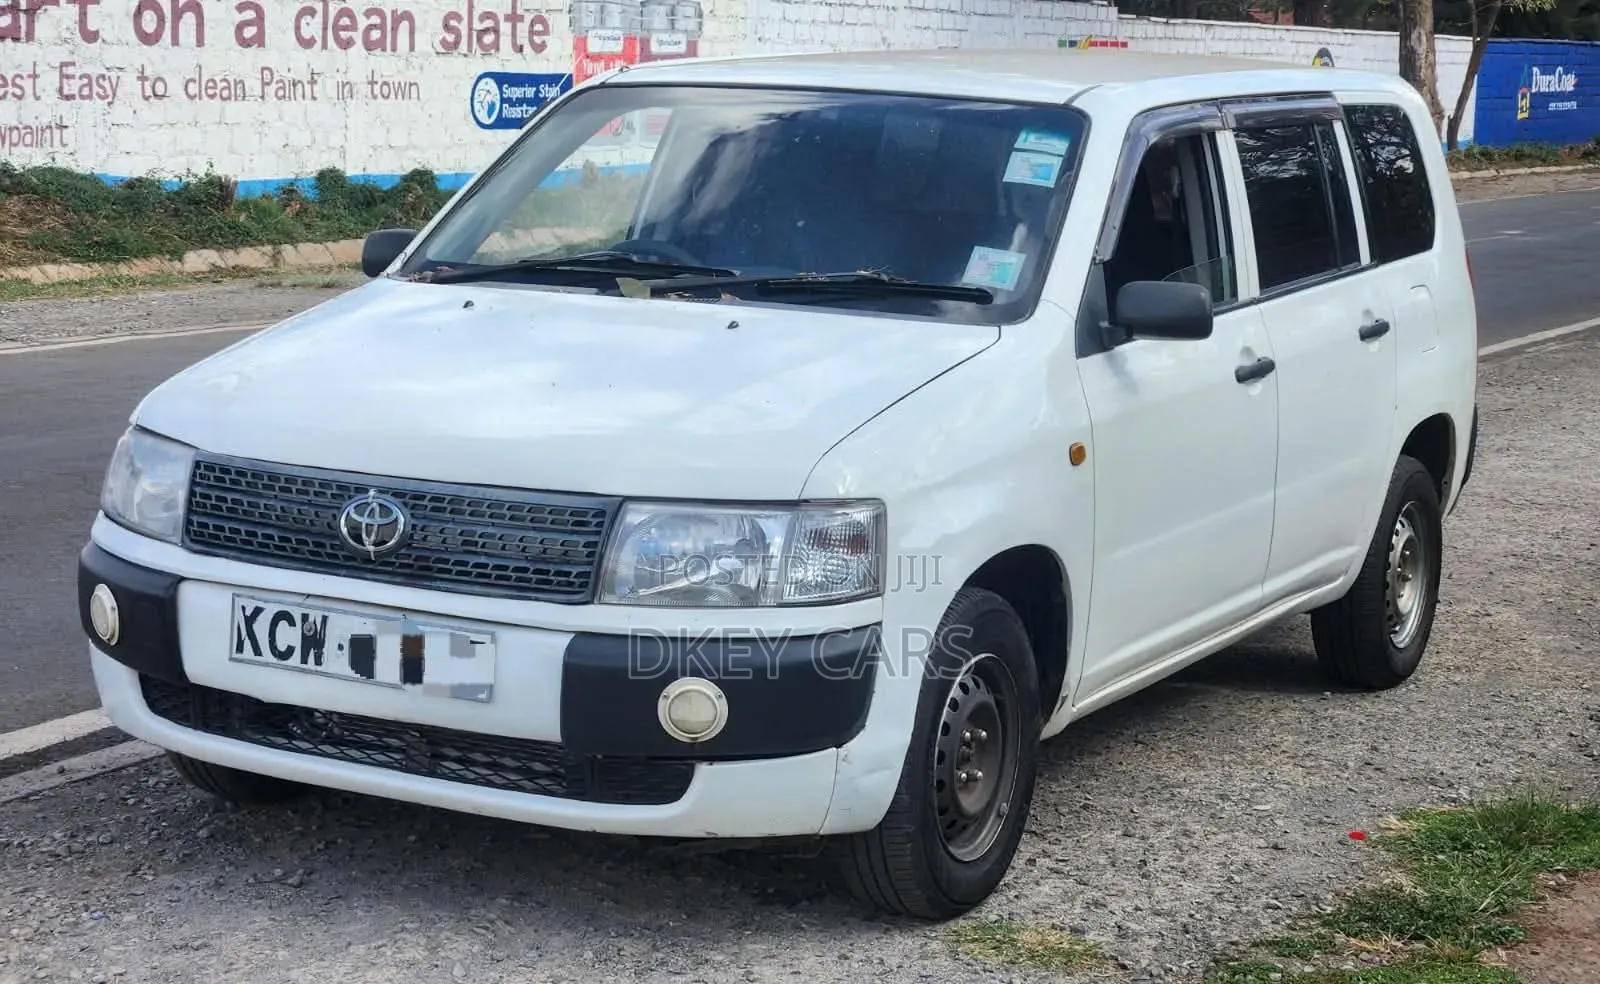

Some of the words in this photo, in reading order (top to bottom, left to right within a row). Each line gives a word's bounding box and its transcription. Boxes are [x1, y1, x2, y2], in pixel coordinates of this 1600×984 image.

[132, 0, 206, 48] on
[234, 0, 266, 49] a
[294, 0, 415, 53] clean
[439, 0, 551, 55] slate
[58, 61, 120, 105] Easy
[138, 64, 168, 98] to
[184, 65, 246, 101] clean
[260, 66, 318, 101] Paint
[337, 71, 353, 101] in
[368, 68, 420, 101] town
[502, 83, 536, 102] Superior
[1531, 65, 1577, 93] DuraCoat
[235, 604, 328, 667] KCW
